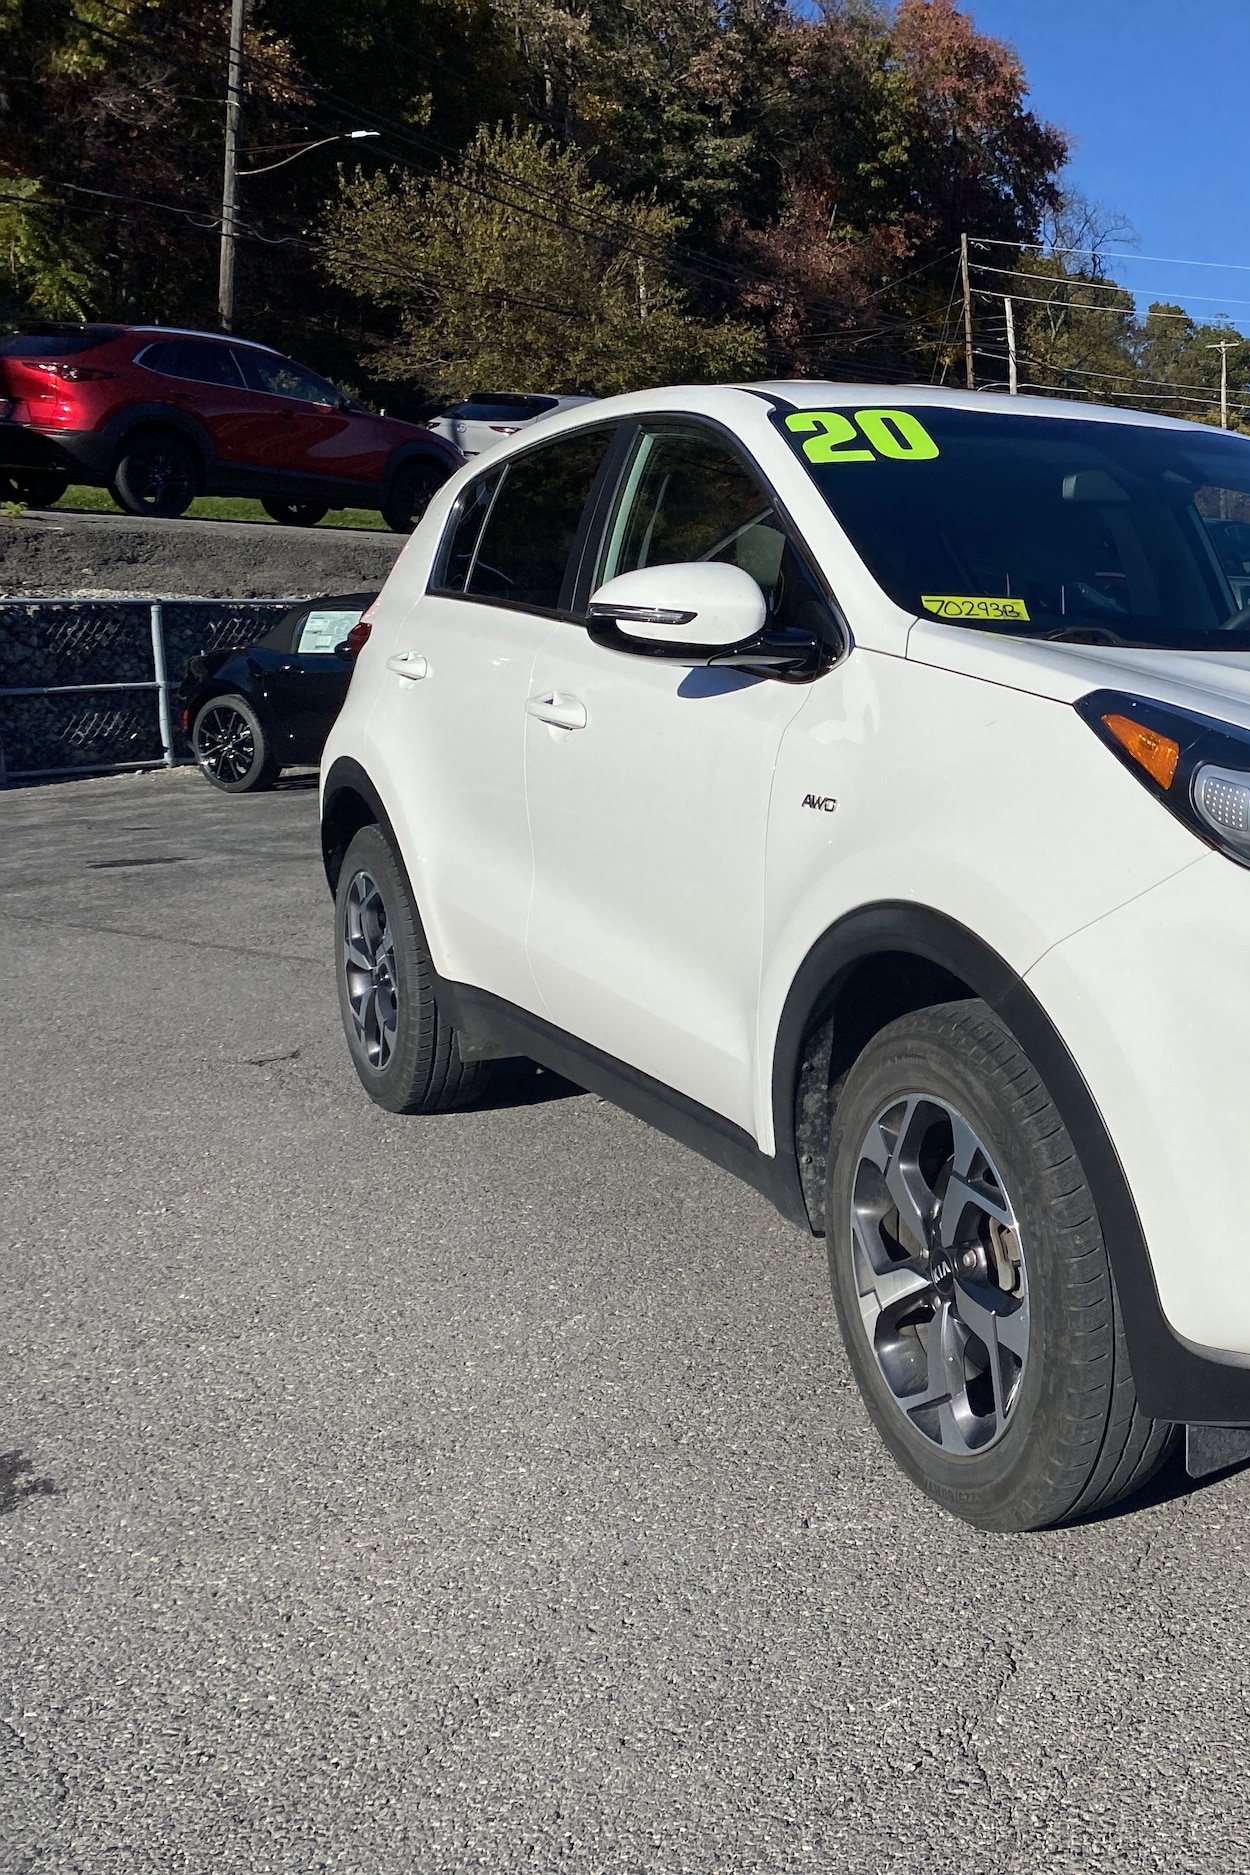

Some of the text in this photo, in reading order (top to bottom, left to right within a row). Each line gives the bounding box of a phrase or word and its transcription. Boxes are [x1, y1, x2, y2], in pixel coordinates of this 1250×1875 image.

[785, 409, 939, 463] 20
[924, 600, 1020, 618] 70293B
[801, 794, 836, 812] AWD
[933, 1261, 951, 1283] KIA
